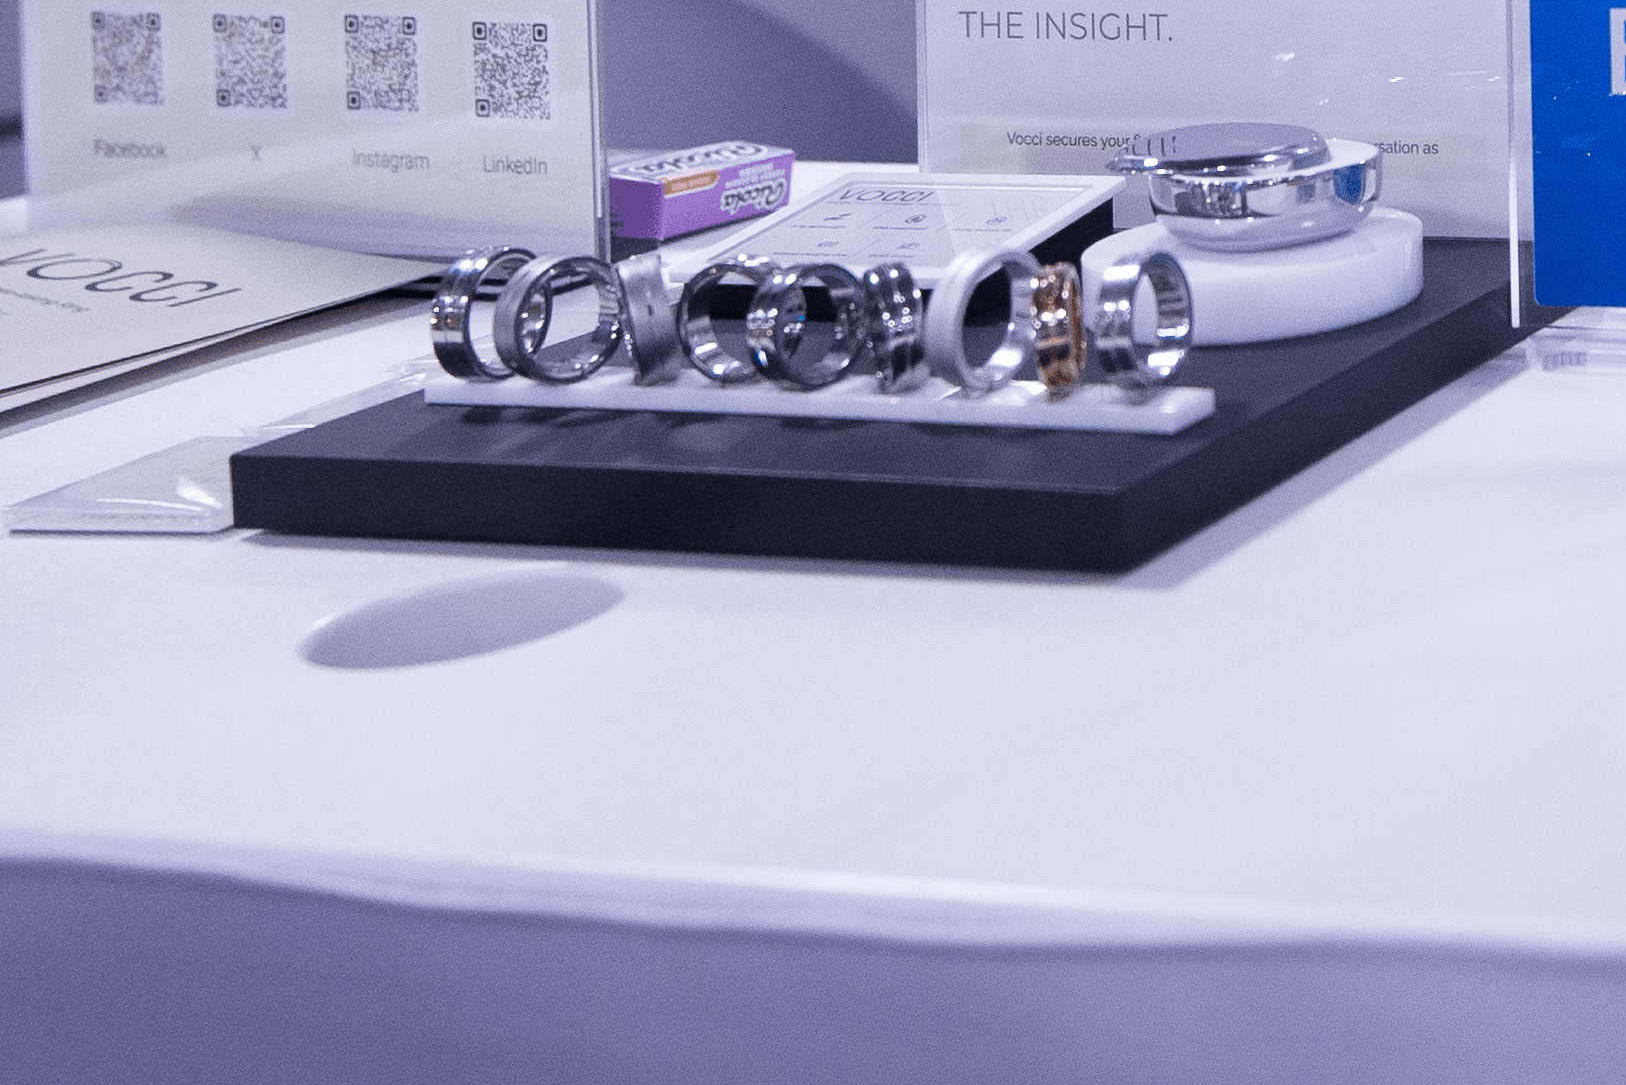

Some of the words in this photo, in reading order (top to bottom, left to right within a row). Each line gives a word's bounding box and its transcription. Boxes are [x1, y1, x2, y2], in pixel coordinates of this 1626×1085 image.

[958, 11, 1024, 40] THE
[1035, 11, 1174, 42] INSIGHT.
[93, 137, 167, 161] Facebook
[353, 149, 430, 173] Instagram
[483, 155, 548, 176] LinkedIn
[1007, 132, 1043, 146] Vocci
[1046, 134, 1098, 147] secures
[1422, 143, 1439, 155] as
[839, 188, 936, 203] VOCCI
[0, 248, 242, 308] VOCCI
